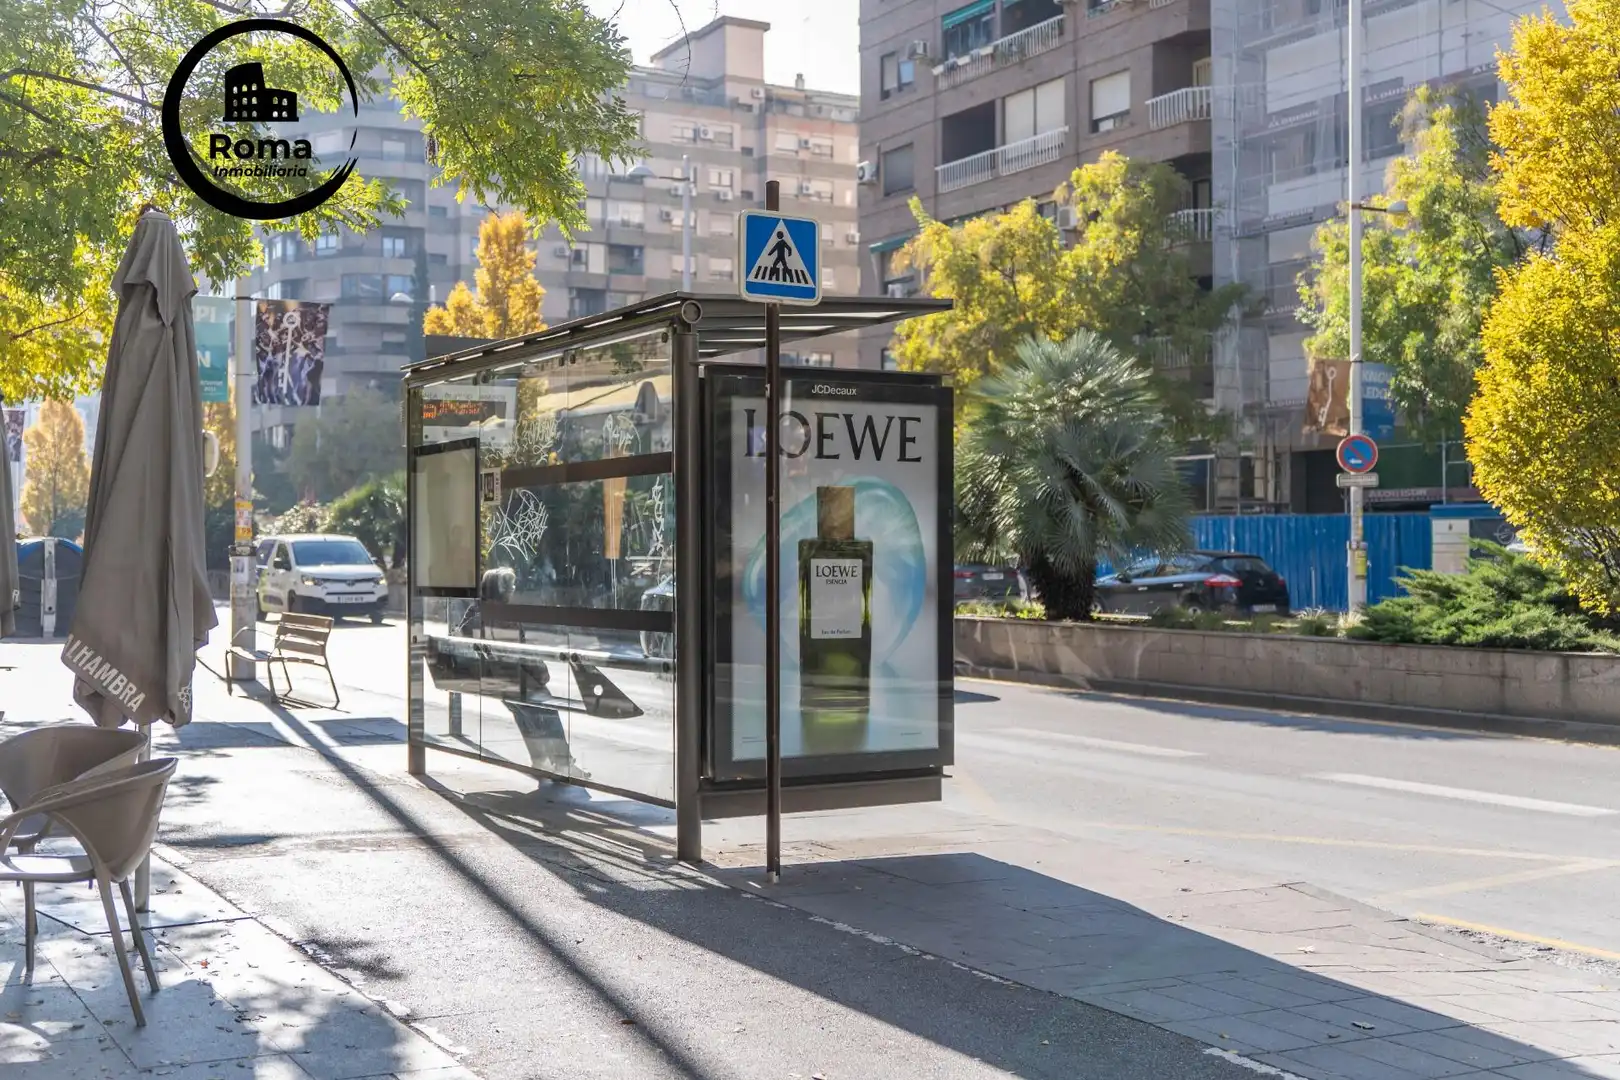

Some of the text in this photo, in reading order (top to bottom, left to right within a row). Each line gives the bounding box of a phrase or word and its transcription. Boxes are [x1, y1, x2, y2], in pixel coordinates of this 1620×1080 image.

[811, 384, 857, 396] JCDecaux
[744, 408, 922, 463] LOEWE
[816, 565, 858, 578] LOEWE
